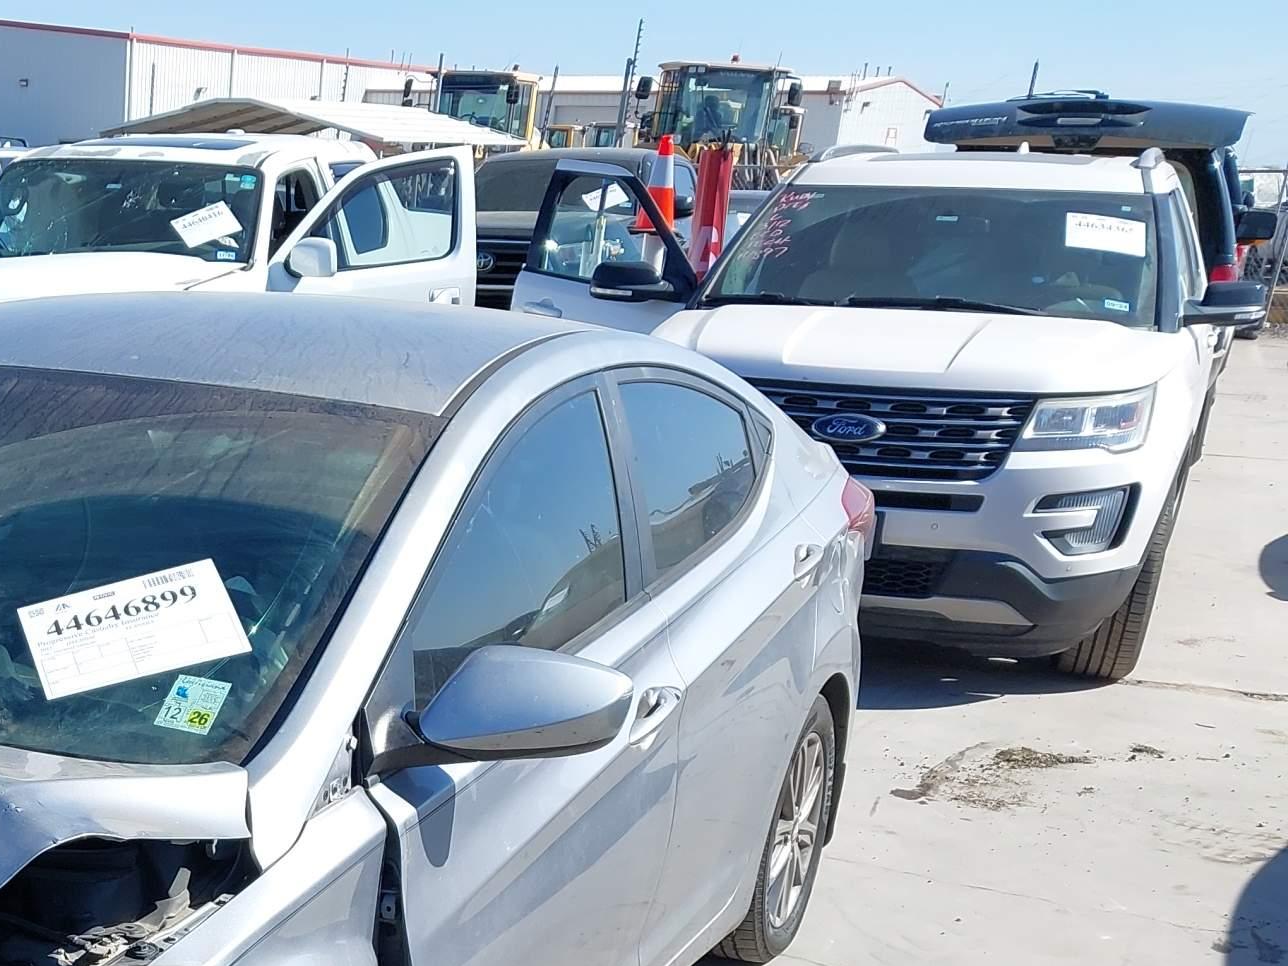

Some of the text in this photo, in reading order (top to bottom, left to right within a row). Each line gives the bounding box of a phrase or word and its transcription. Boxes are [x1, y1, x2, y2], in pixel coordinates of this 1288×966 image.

[827, 417, 867, 436] Ford
[46, 585, 197, 636] 44646899
[163, 705, 182, 720] 12
[188, 710, 211, 726] 26
